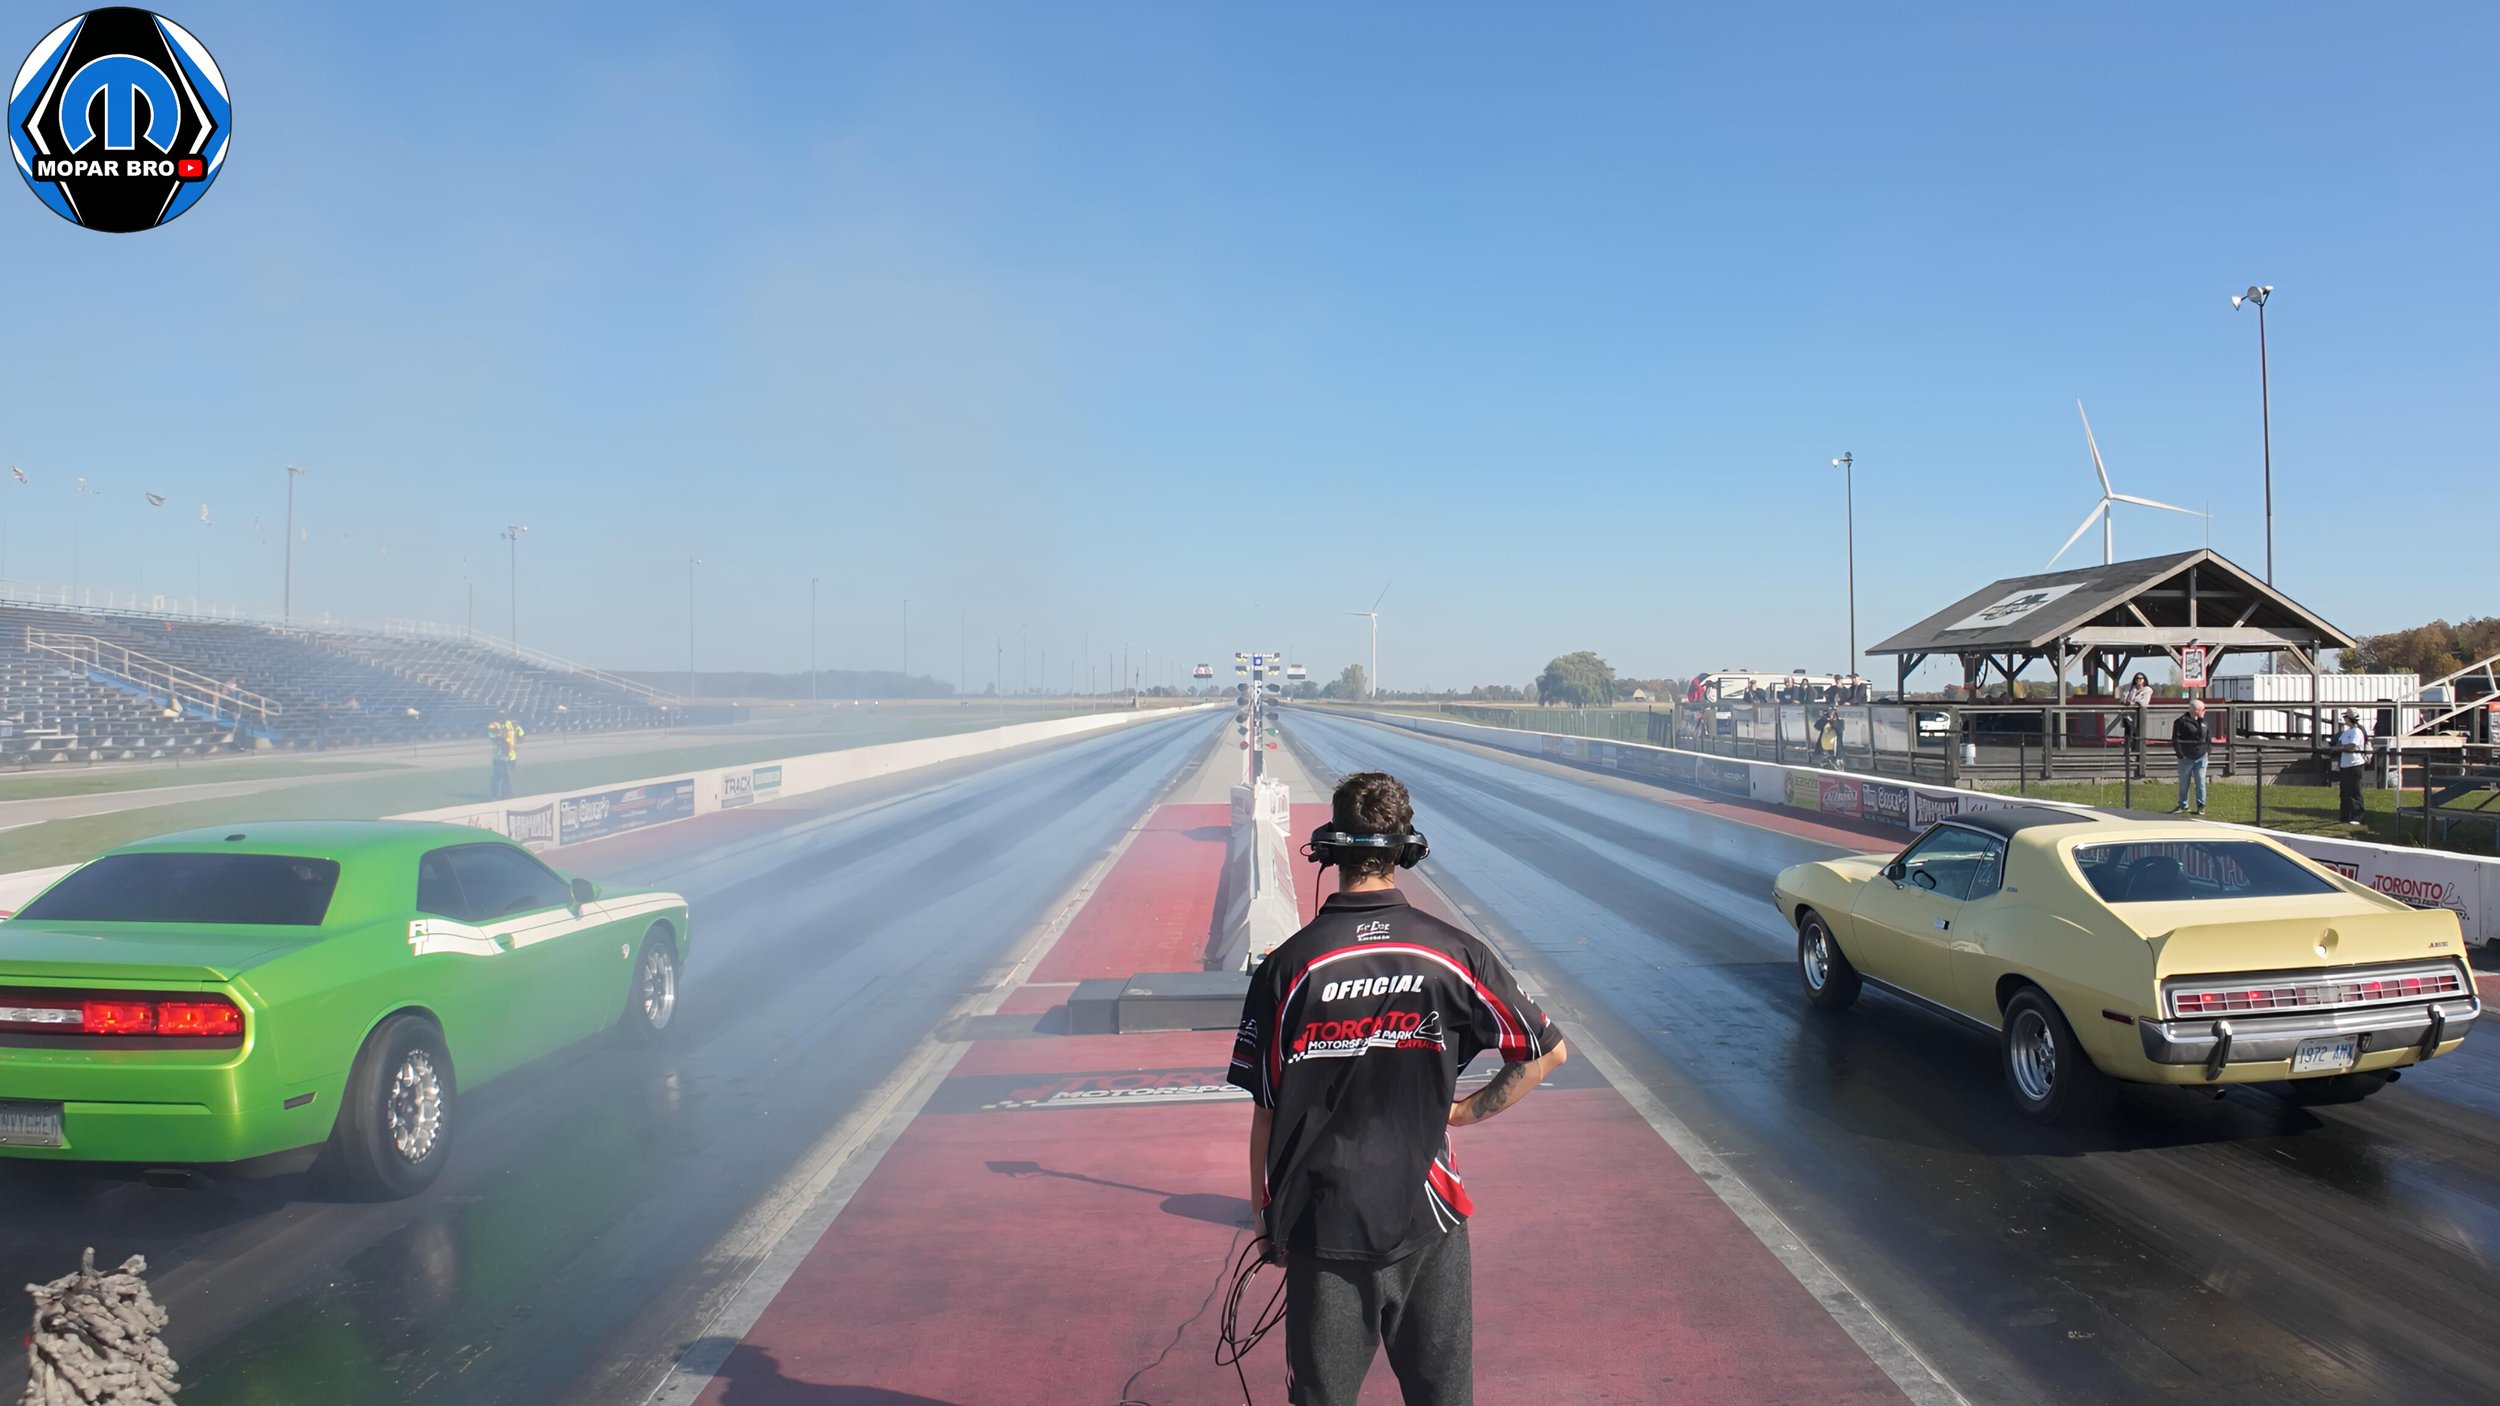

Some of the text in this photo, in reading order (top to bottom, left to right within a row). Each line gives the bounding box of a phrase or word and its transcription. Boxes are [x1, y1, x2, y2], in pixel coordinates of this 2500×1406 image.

[2375, 874, 2443, 900] TORONTO
[1321, 974, 1425, 1003] OFFICIAL
[1306, 1010, 1421, 1043] TORONTO
[1382, 1030, 1413, 1040] PARK
[2299, 1046, 2328, 1064] 1972
